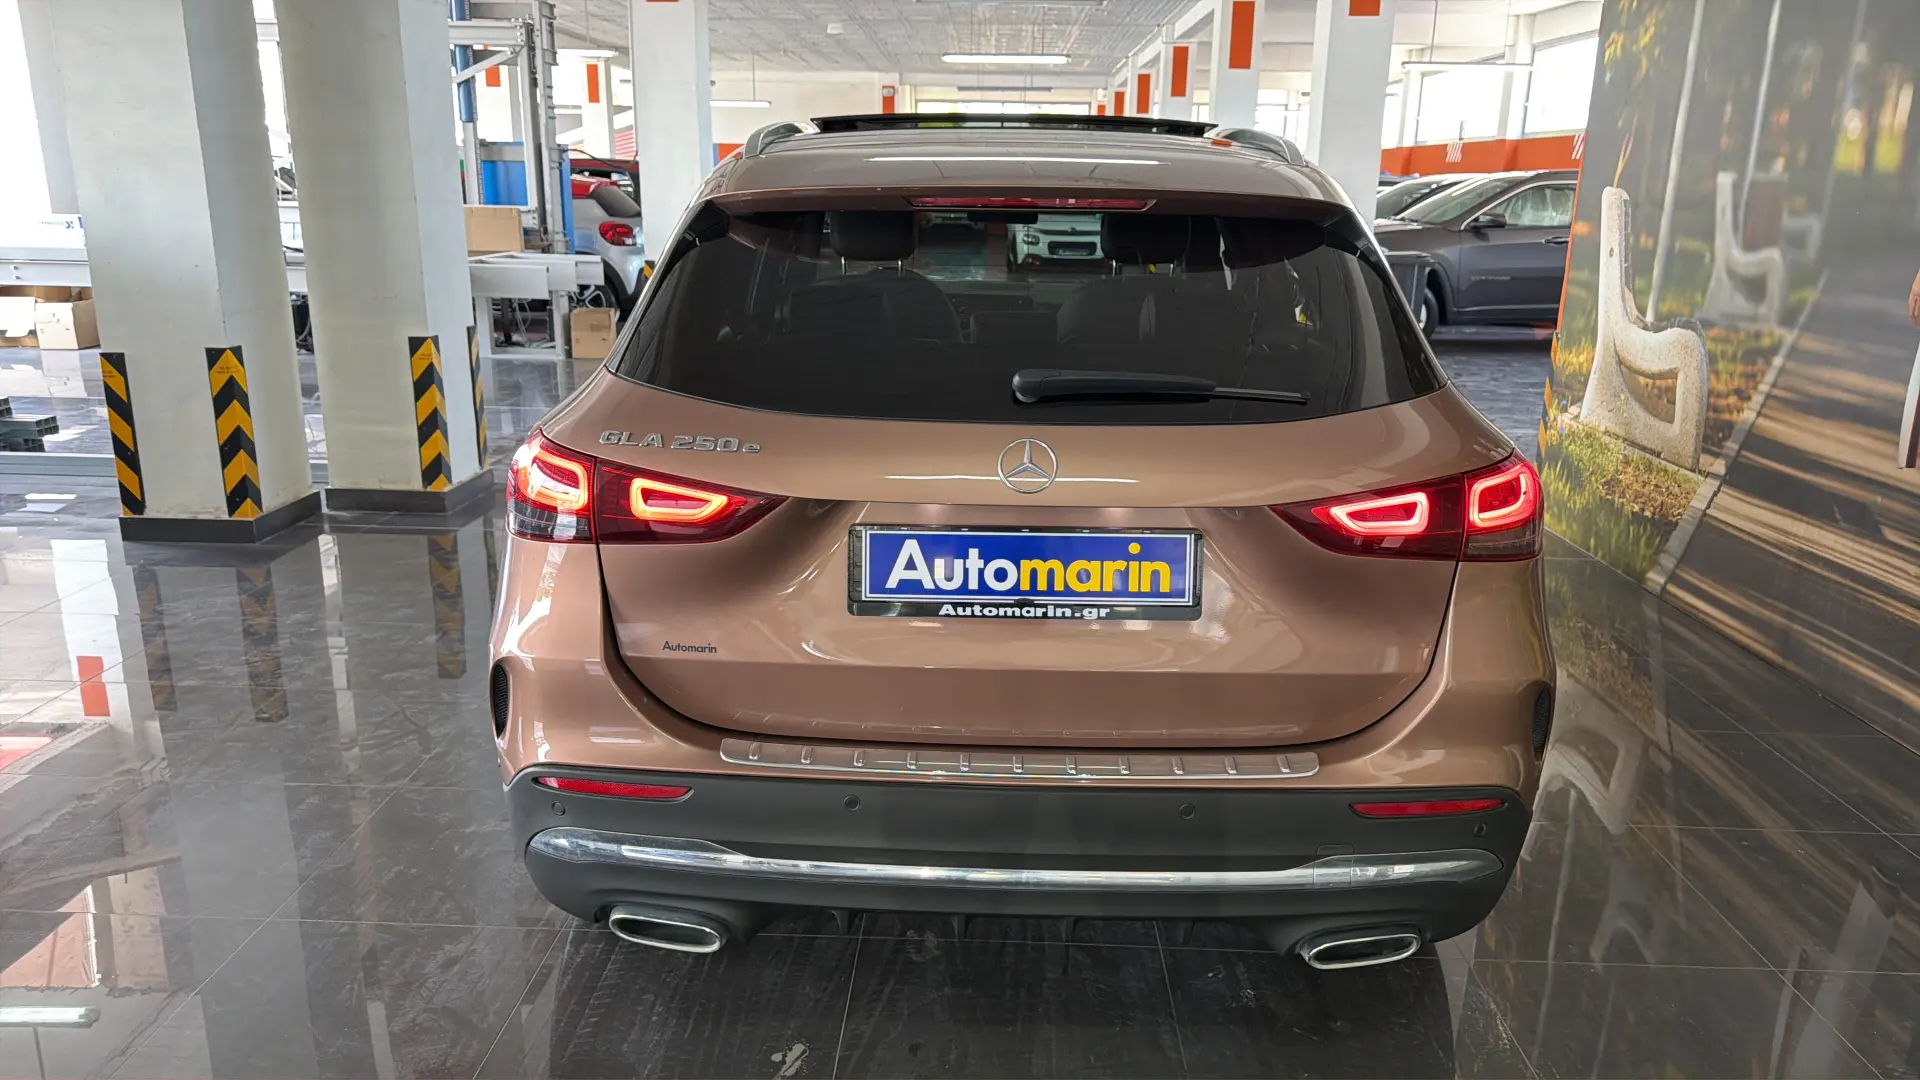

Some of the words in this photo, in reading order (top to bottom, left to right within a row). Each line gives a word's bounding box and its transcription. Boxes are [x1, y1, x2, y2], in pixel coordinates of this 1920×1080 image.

[599, 430, 663, 448] GLA
[884, 538, 1171, 593] Automarin
[938, 603, 1111, 620] Automarin.gr
[662, 640, 718, 654] Automarin
